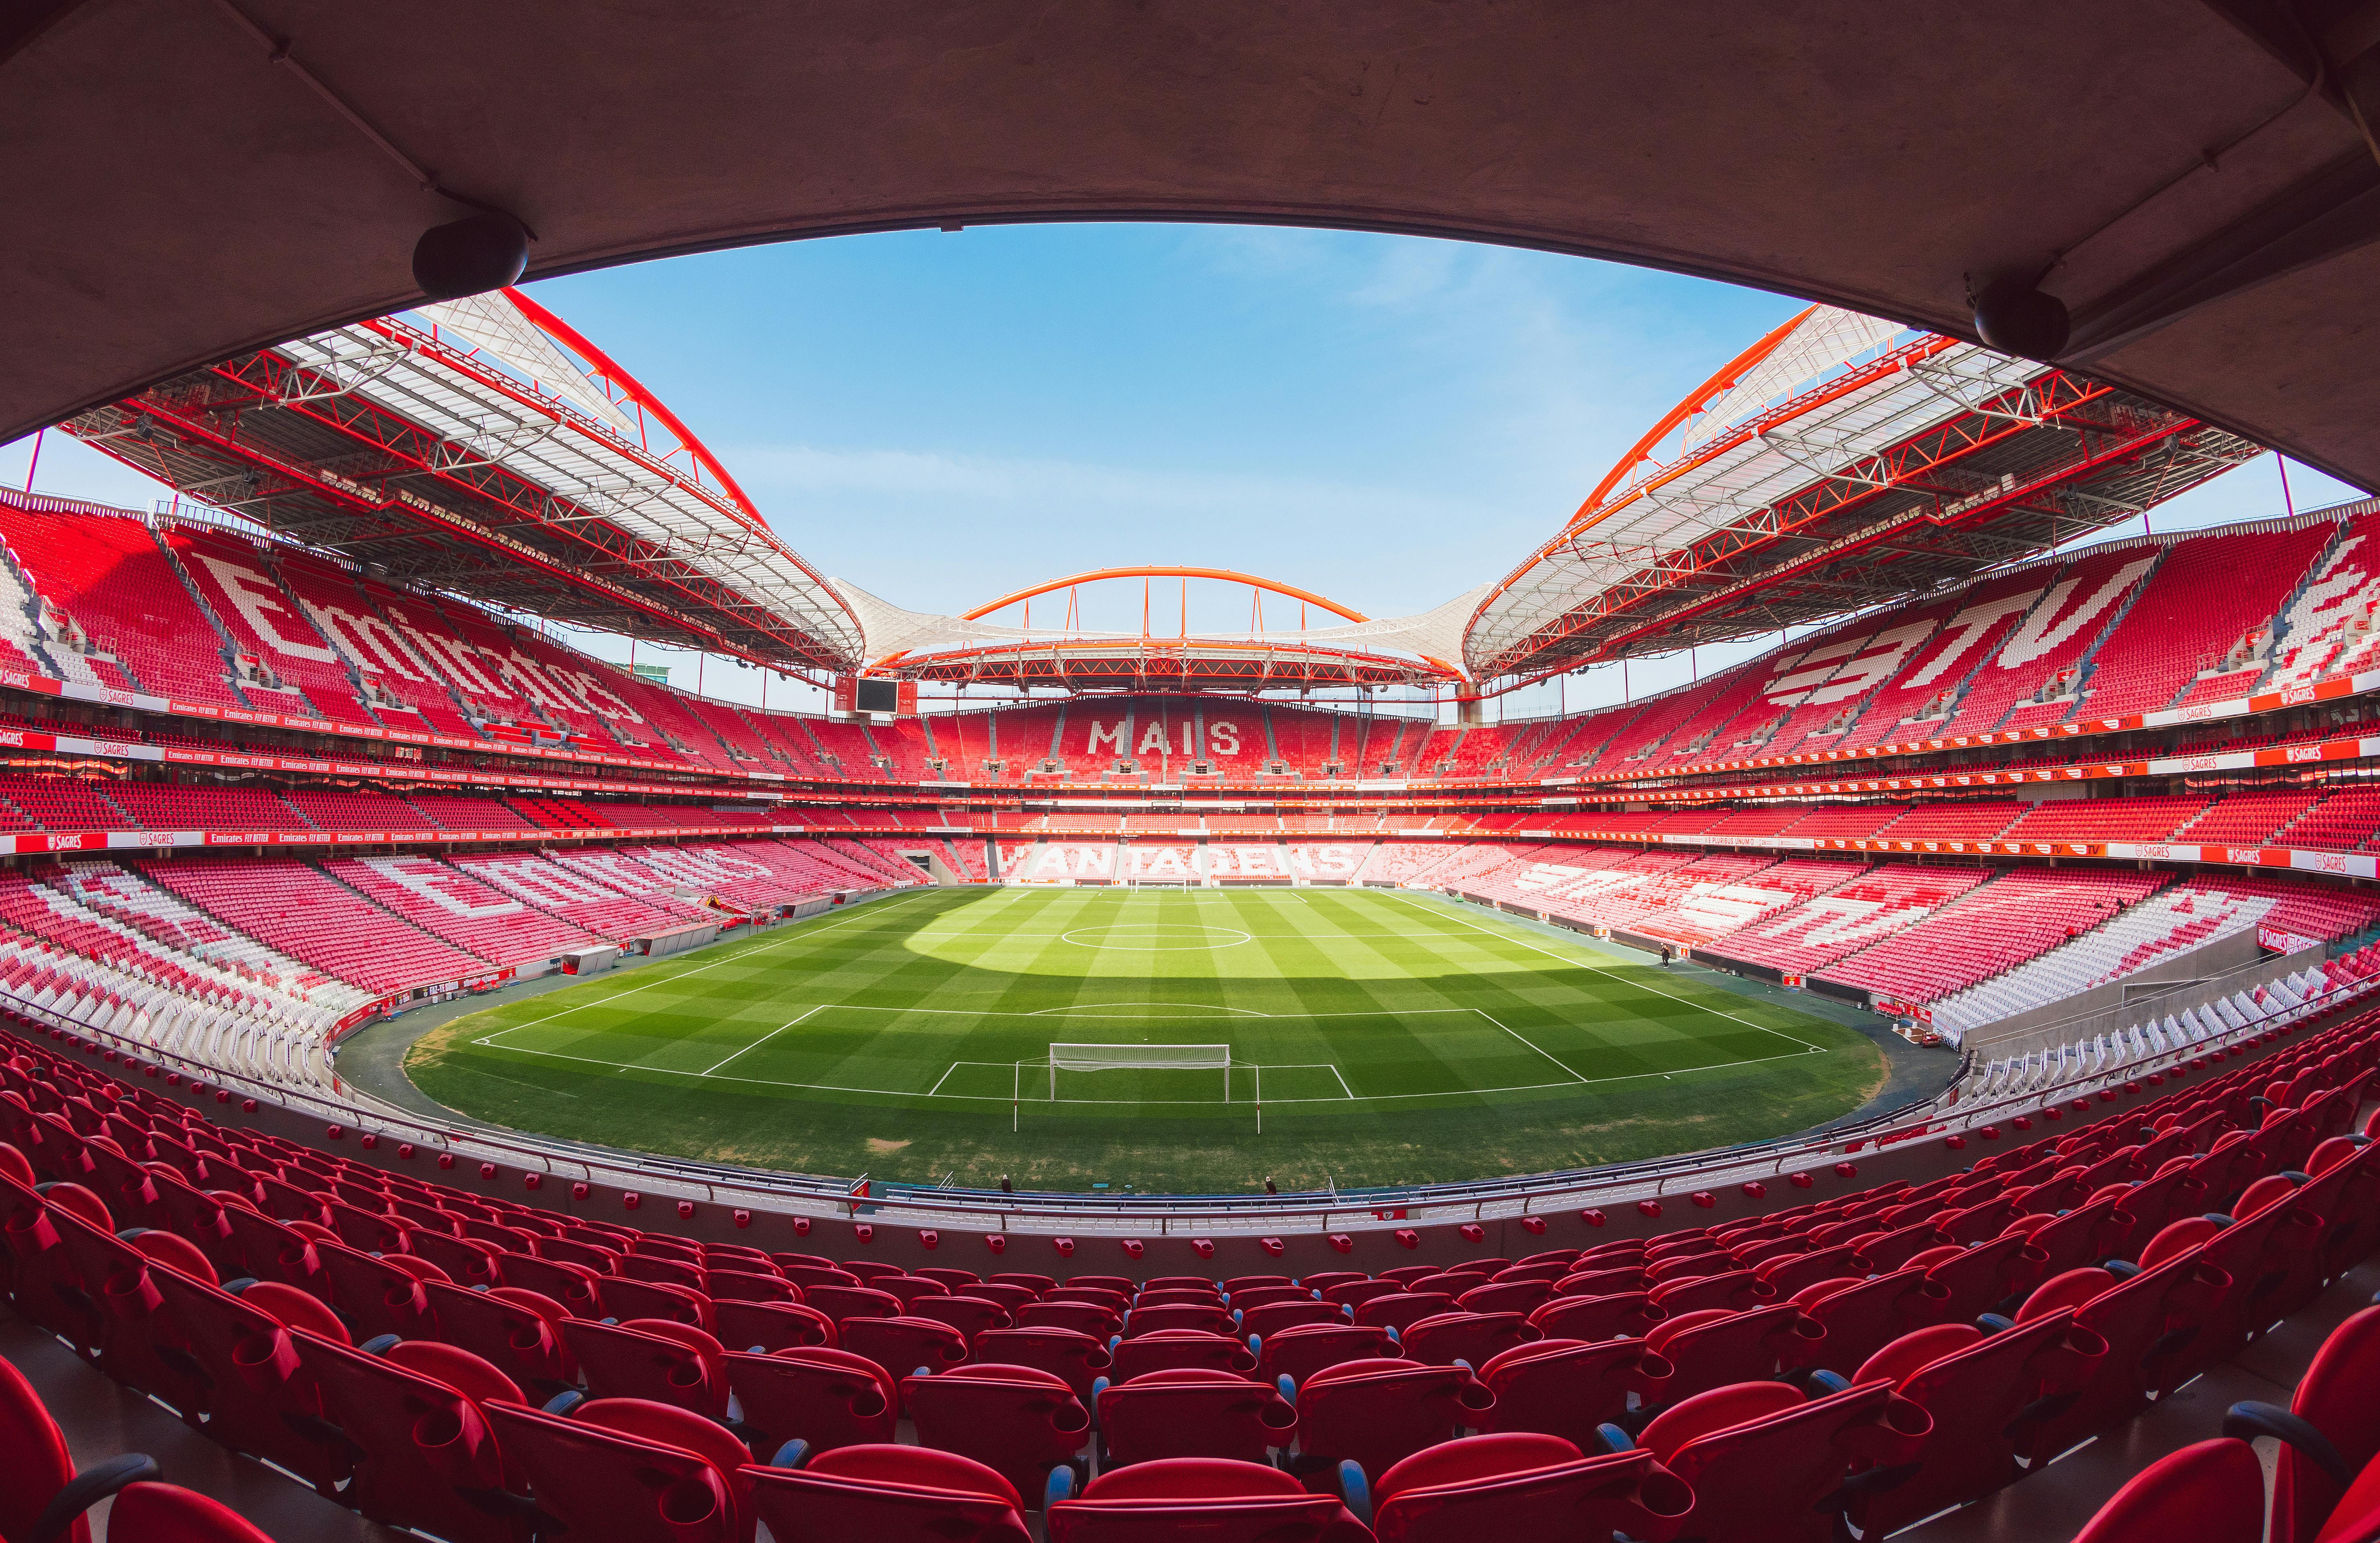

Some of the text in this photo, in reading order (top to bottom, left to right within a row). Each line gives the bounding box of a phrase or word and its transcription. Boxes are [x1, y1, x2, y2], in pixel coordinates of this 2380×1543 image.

[192, 552, 643, 724] Emirates
[4, 670, 29, 688] SAGRES
[108, 690, 134, 705] SAGRES
[2289, 688, 2315, 704] SAGRES
[173, 703, 197, 712] Emirates
[2186, 706, 2211, 720] SAGRES
[225, 709, 253, 720] Emirates
[263, 715, 277, 723] BETTER
[285, 717, 310, 727] Emirates
[340, 725, 363, 734] Emirates
[389, 731, 410, 740] Emirates
[1088, 721, 1240, 755] MAIS
[103, 742, 129, 756] SAGRES
[2294, 745, 2321, 761] SAGRES
[221, 755, 249, 764] Emirates
[259, 758, 274, 766] BETTER
[282, 760, 307, 769] Emirates
[2191, 757, 2216, 770] SAGRES
[337, 765, 360, 773] Emirates
[56, 834, 81, 850] SAGRES
[148, 833, 174, 845] SAGRES
[212, 834, 242, 842] Emirates
[253, 834, 269, 842] BETTER
[2144, 845, 2169, 858] SAGRES
[2235, 848, 2260, 864] SAGRES
[984, 846, 1355, 875] VANTAGENS
[2323, 855, 2346, 872] SAGRES
[353, 845, 773, 918] Emirates
[2265, 929, 2287, 951] SAGRES
[430, 984, 445, 995] FAZ-TE
